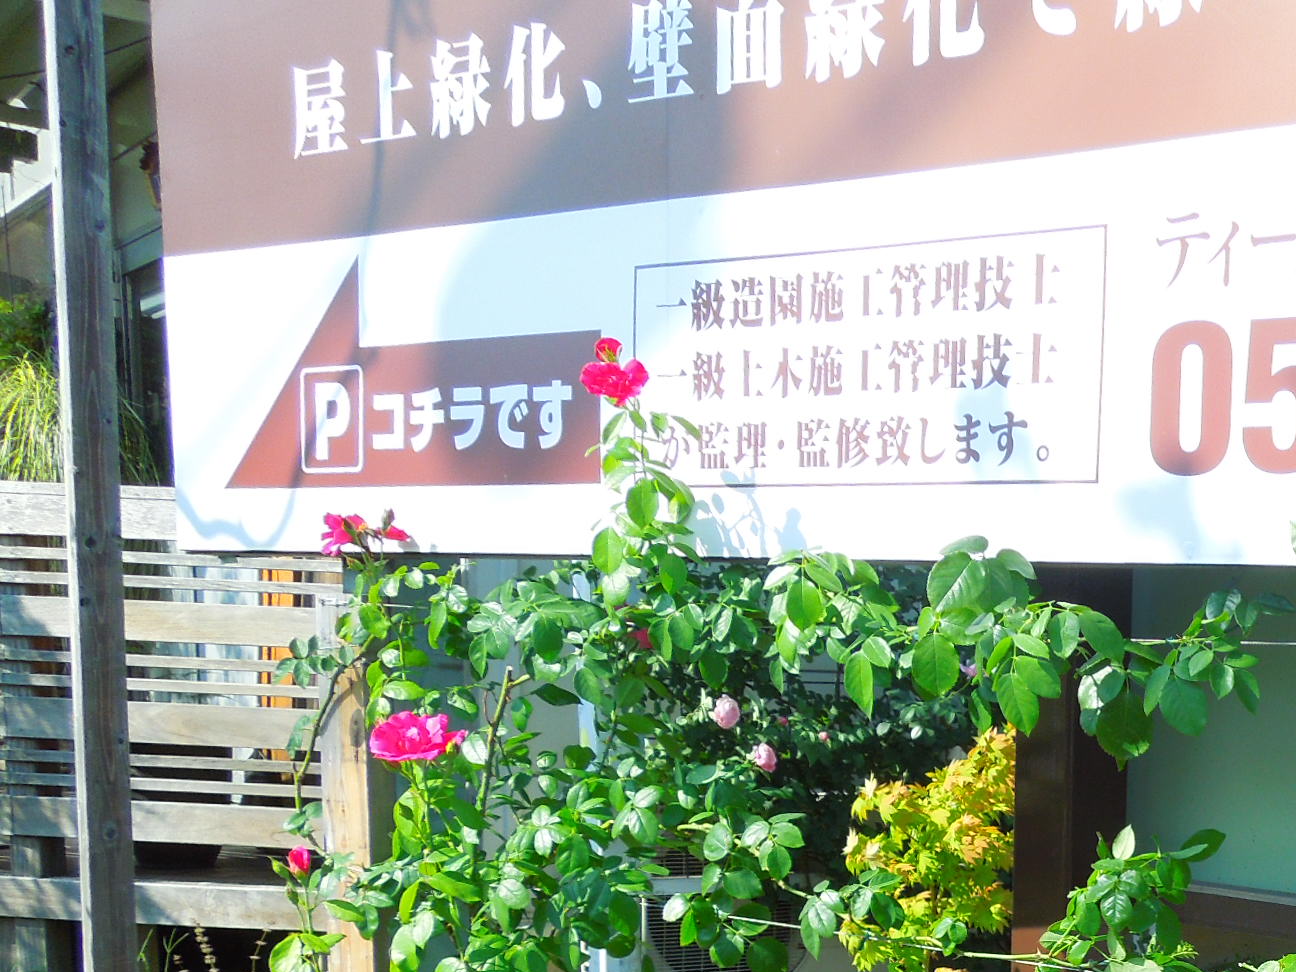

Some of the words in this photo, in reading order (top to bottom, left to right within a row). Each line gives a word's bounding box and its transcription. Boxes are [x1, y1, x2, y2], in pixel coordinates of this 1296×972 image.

[655, 253, 1061, 332] 一級造園施工管理技士
[656, 332, 1057, 402] 一級土木施工管理技士
[313, 380, 351, 461] P
[372, 378, 573, 453] コチラです
